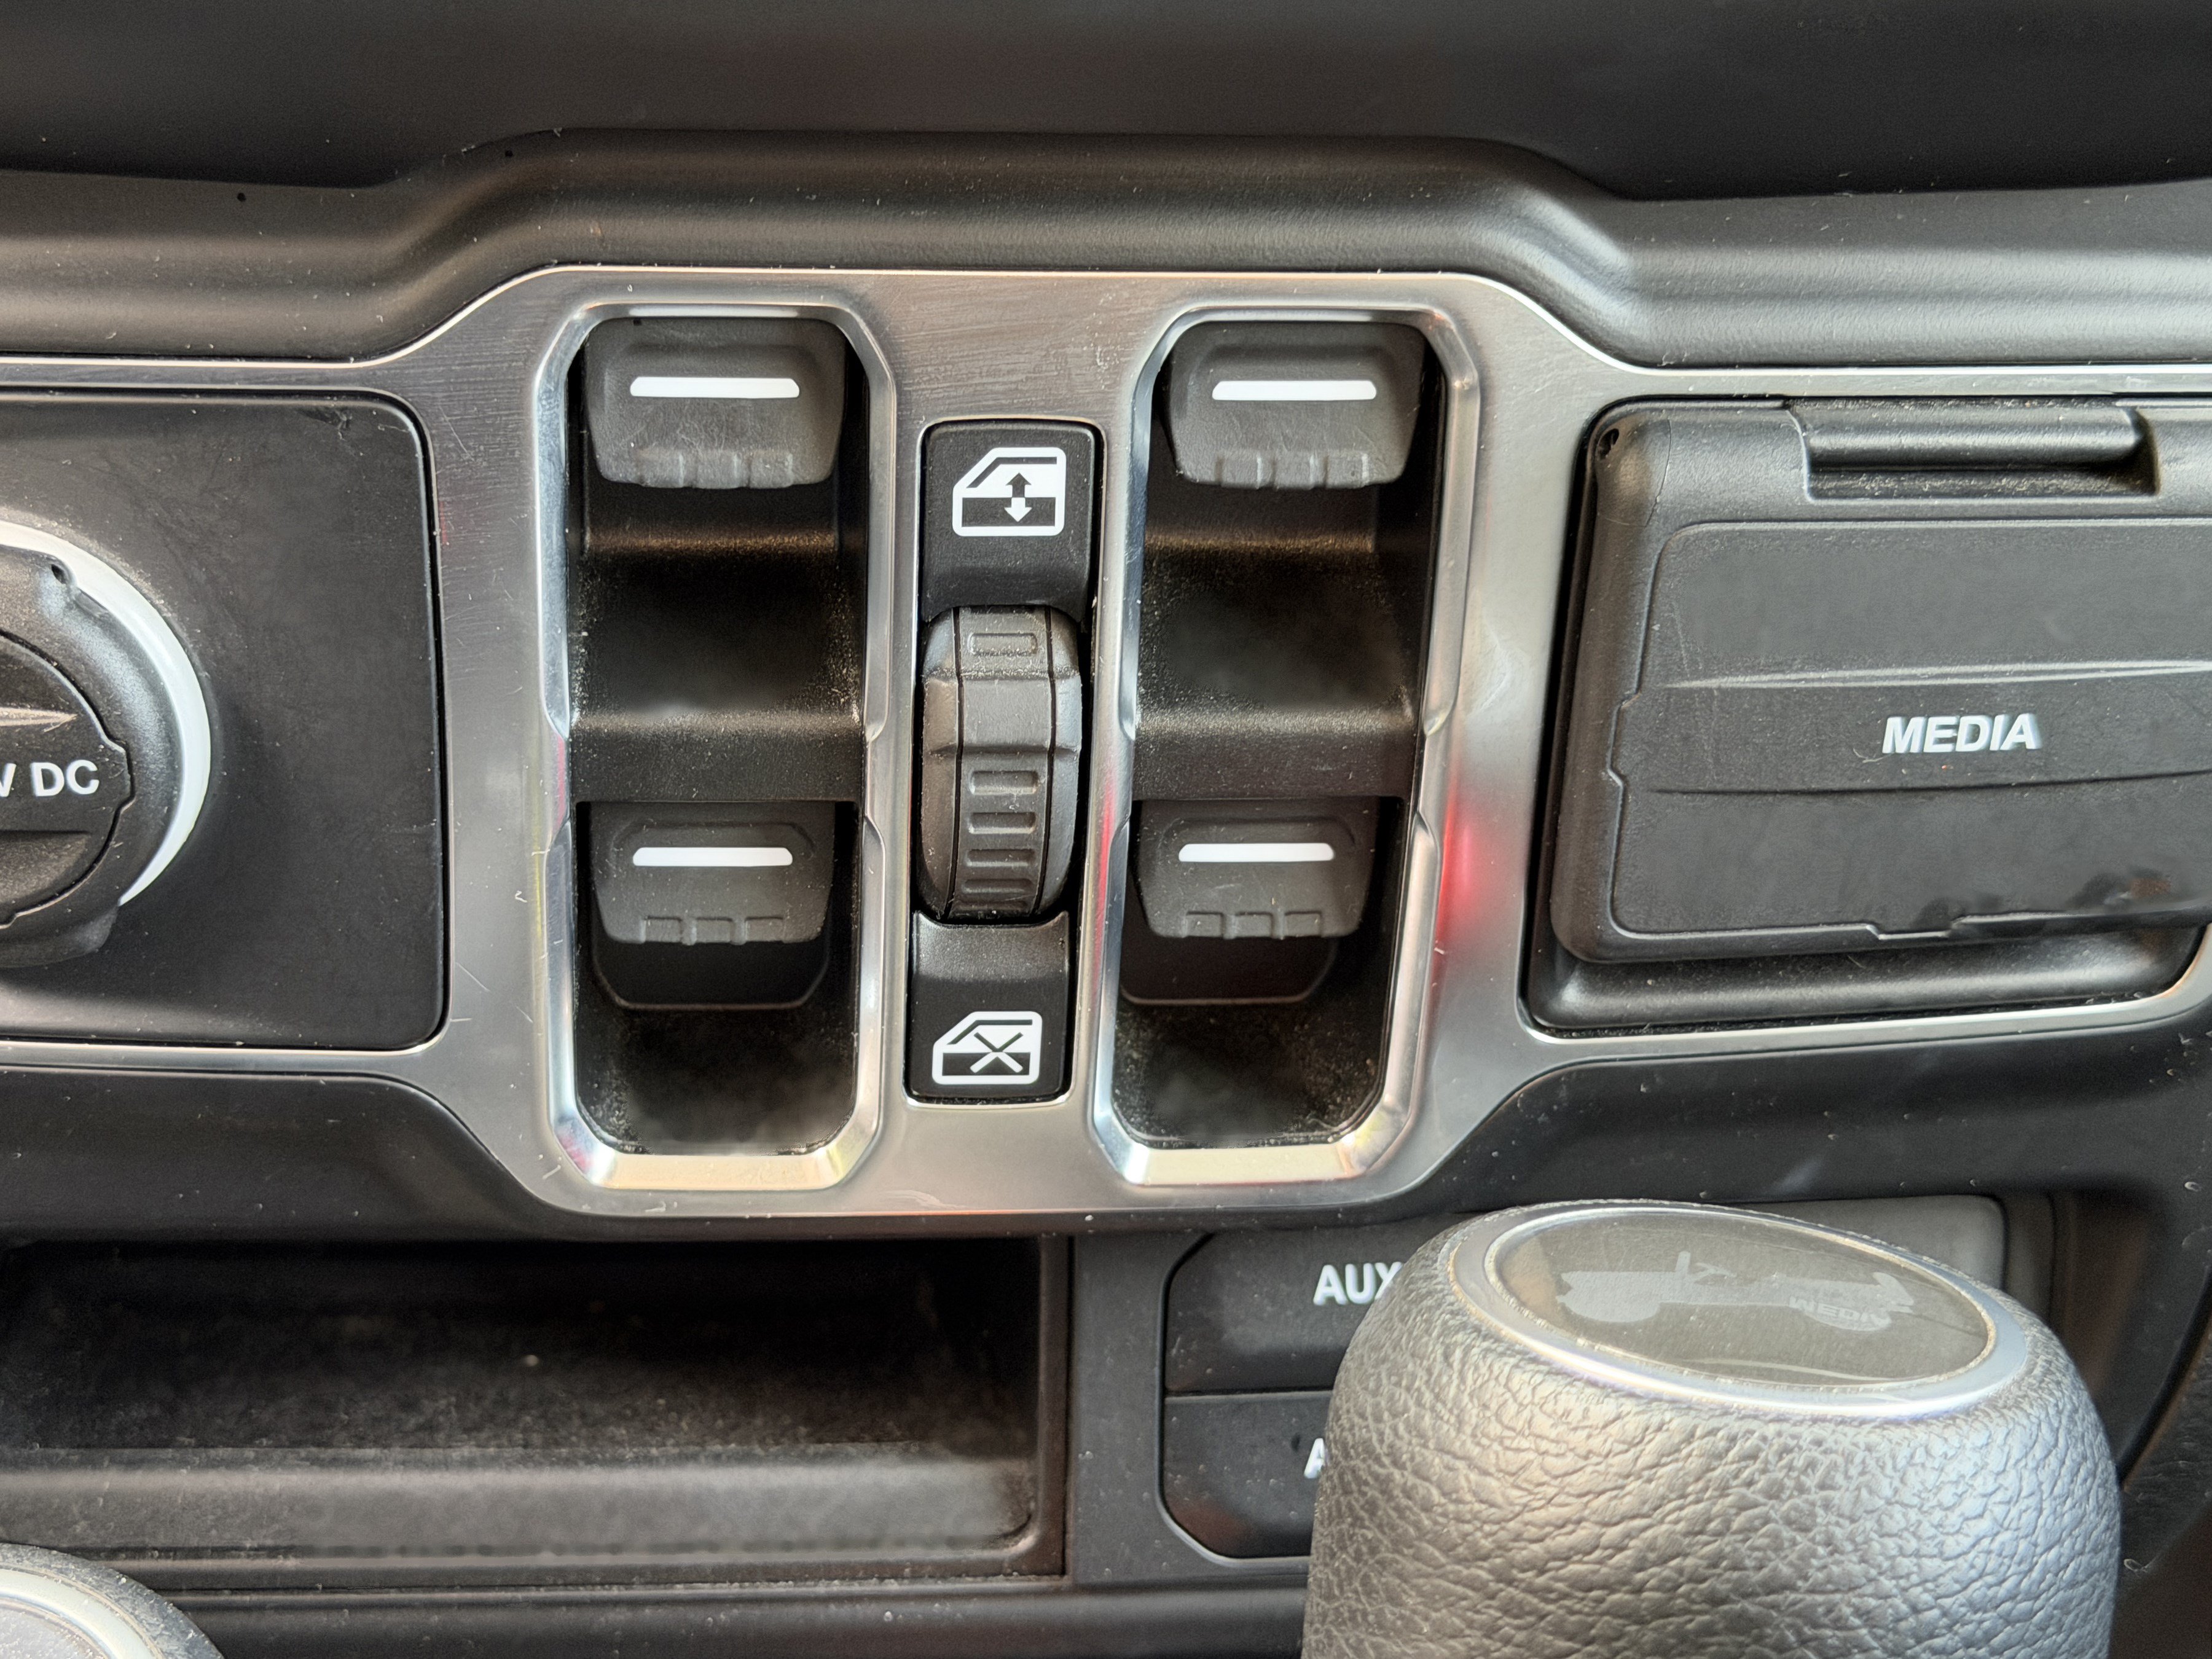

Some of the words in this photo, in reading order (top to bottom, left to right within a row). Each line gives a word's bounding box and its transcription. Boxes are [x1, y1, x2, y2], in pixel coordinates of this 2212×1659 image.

[1882, 713, 2042, 754] MEDIA
[31, 759, 100, 797] DC
[1313, 1261, 1402, 1305] AUX
